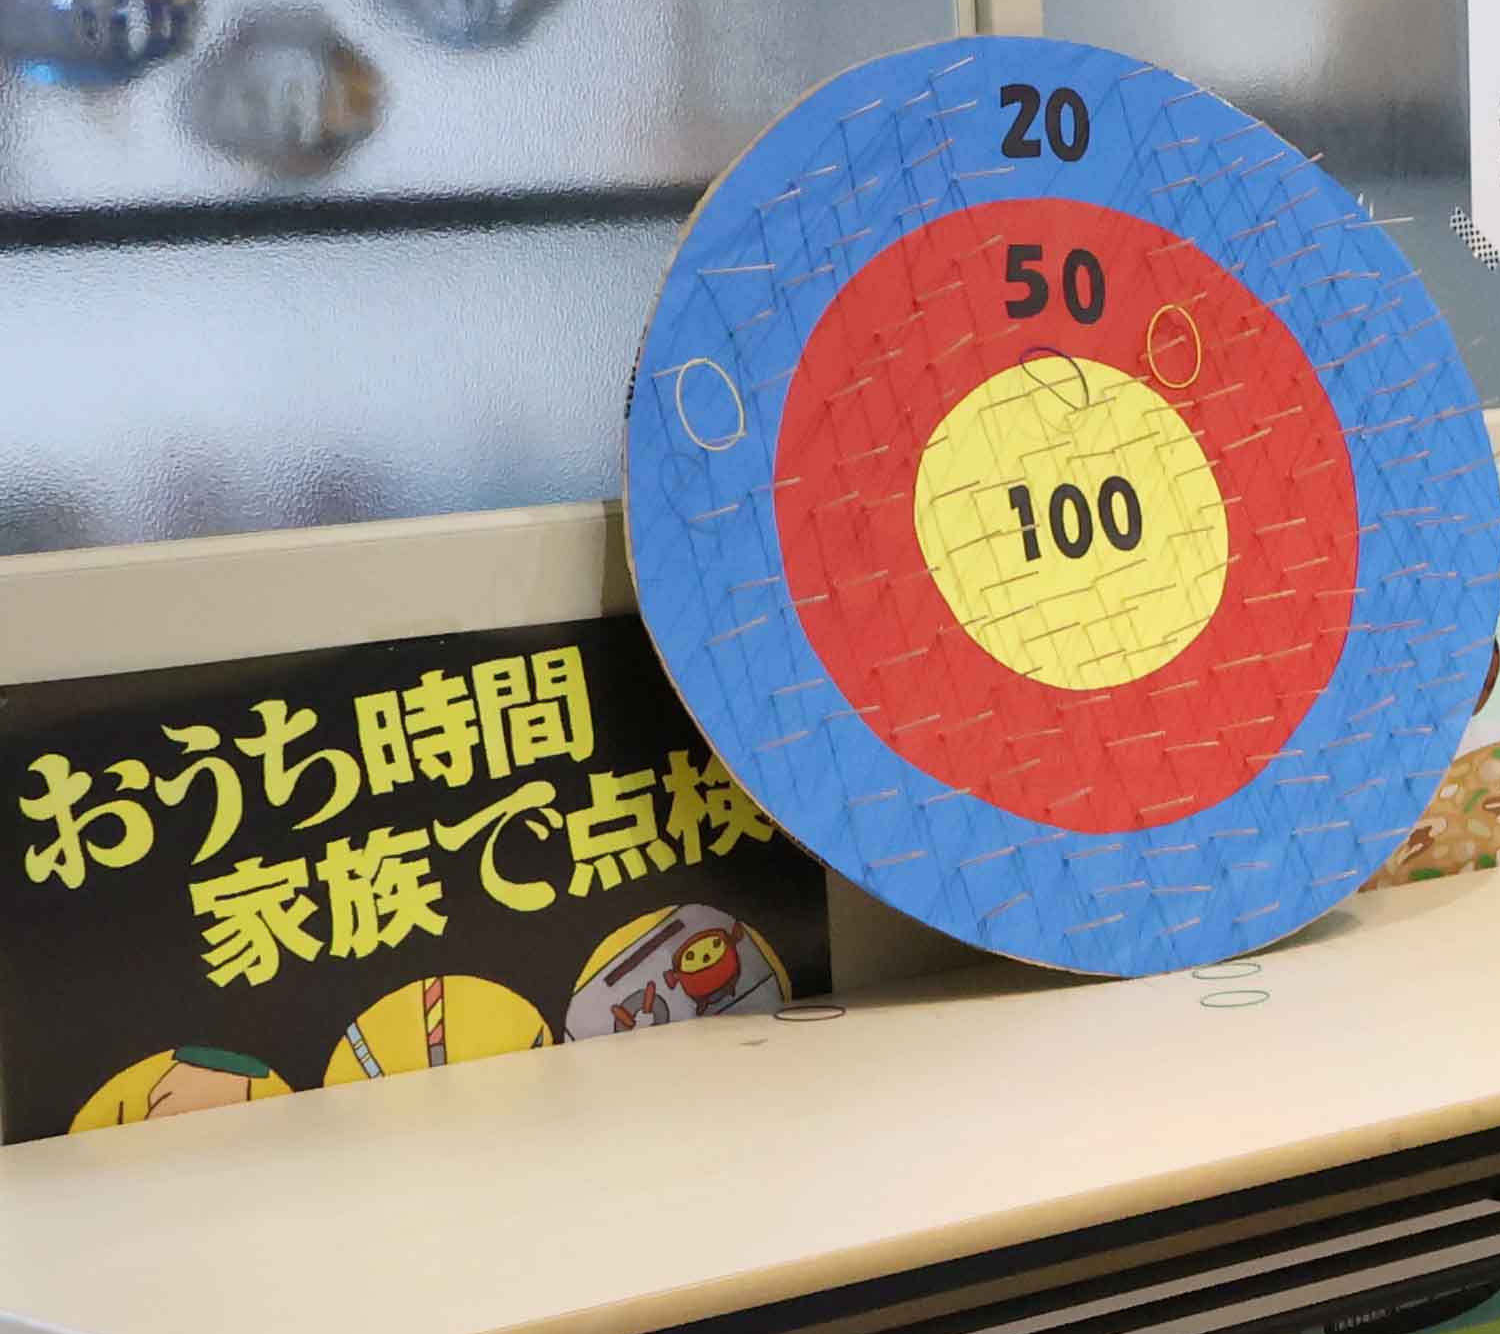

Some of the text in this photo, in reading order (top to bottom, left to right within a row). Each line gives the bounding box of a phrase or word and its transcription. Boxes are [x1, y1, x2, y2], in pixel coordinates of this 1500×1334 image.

[997, 83, 1091, 164] 20
[1002, 241, 1107, 325] 50
[1008, 474, 1144, 564] 100
[17, 644, 596, 892] おうち時間
[188, 748, 778, 990] 家族で点検
